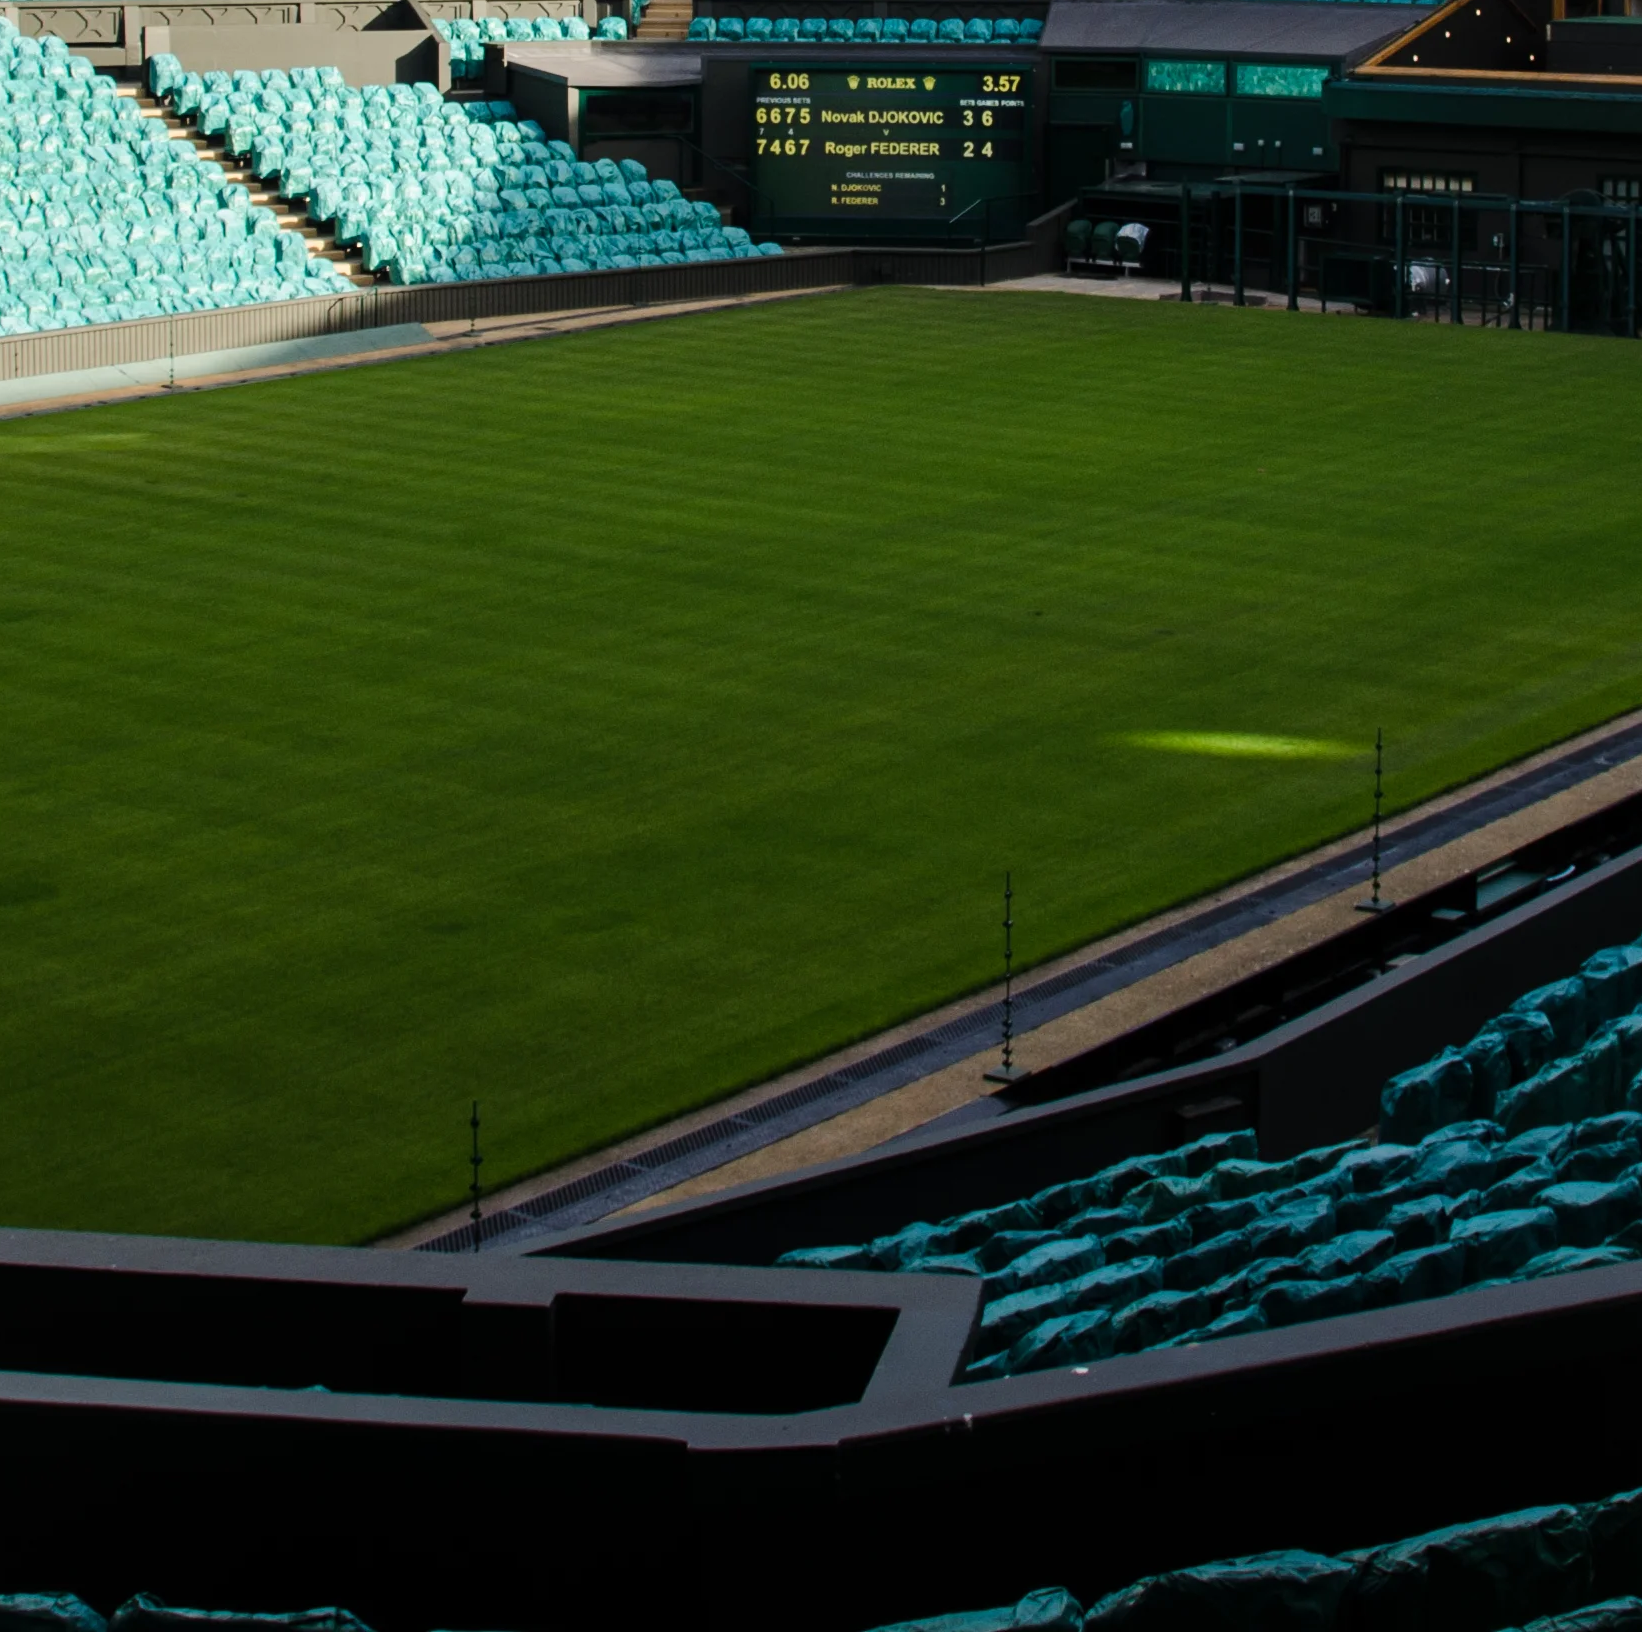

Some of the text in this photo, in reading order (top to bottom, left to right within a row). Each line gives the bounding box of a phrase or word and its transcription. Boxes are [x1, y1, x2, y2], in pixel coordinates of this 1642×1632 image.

[769, 73, 810, 90] 6.06
[866, 77, 916, 90] ROLEX
[982, 75, 1021, 93] 3.57
[756, 96, 791, 104] PREVIOUS
[821, 110, 944, 125] Novak DJOKOVIC
[963, 109, 993, 127] 3 6
[825, 141, 940, 158] Roger FEDERER
[963, 141, 993, 158] 2 4
[846, 171, 935, 180] CHALLENGES REMAINING
[840, 183, 881, 192] DJOKOVIC
[840, 196, 879, 205] FEDERER
